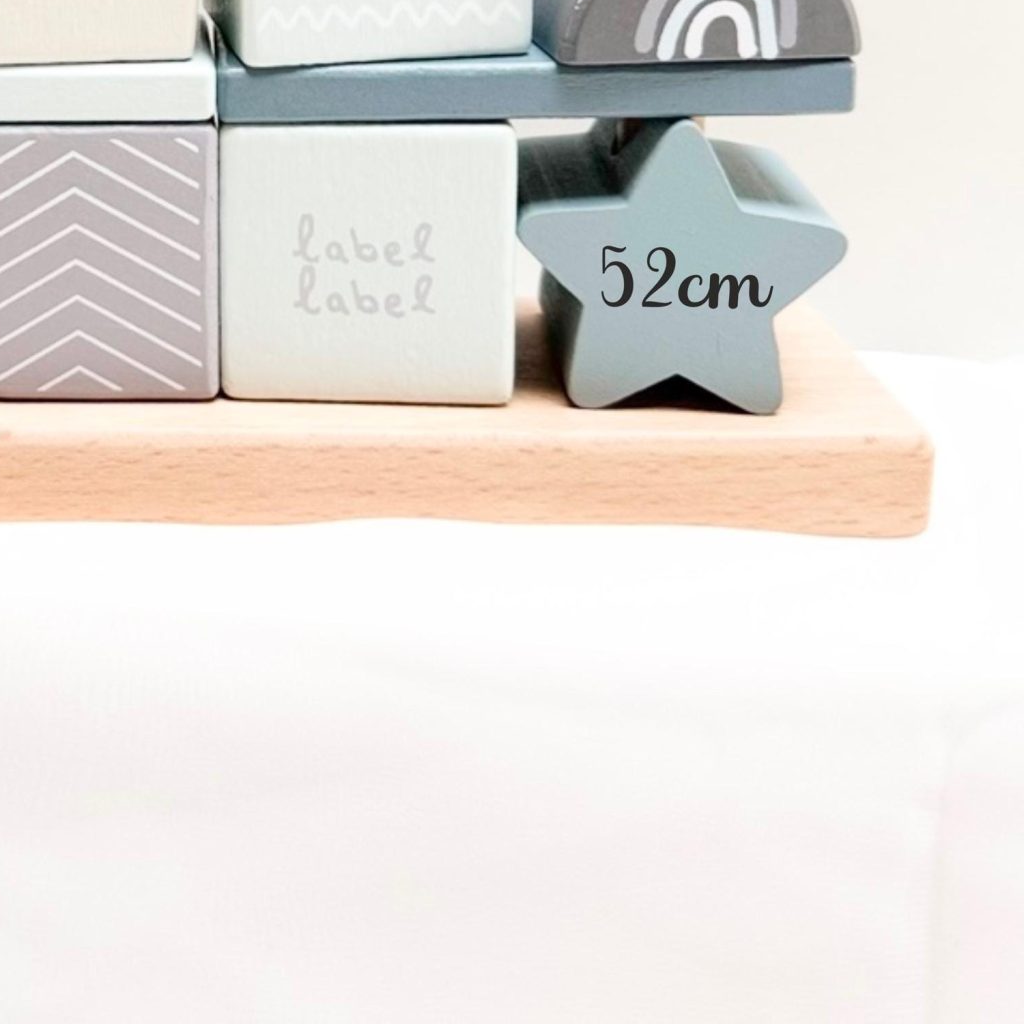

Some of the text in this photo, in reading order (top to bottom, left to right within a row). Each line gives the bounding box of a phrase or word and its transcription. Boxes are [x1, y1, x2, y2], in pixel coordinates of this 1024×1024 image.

[292, 213, 435, 267] label
[293, 264, 436, 319] label
[600, 245, 774, 309] 52cm
